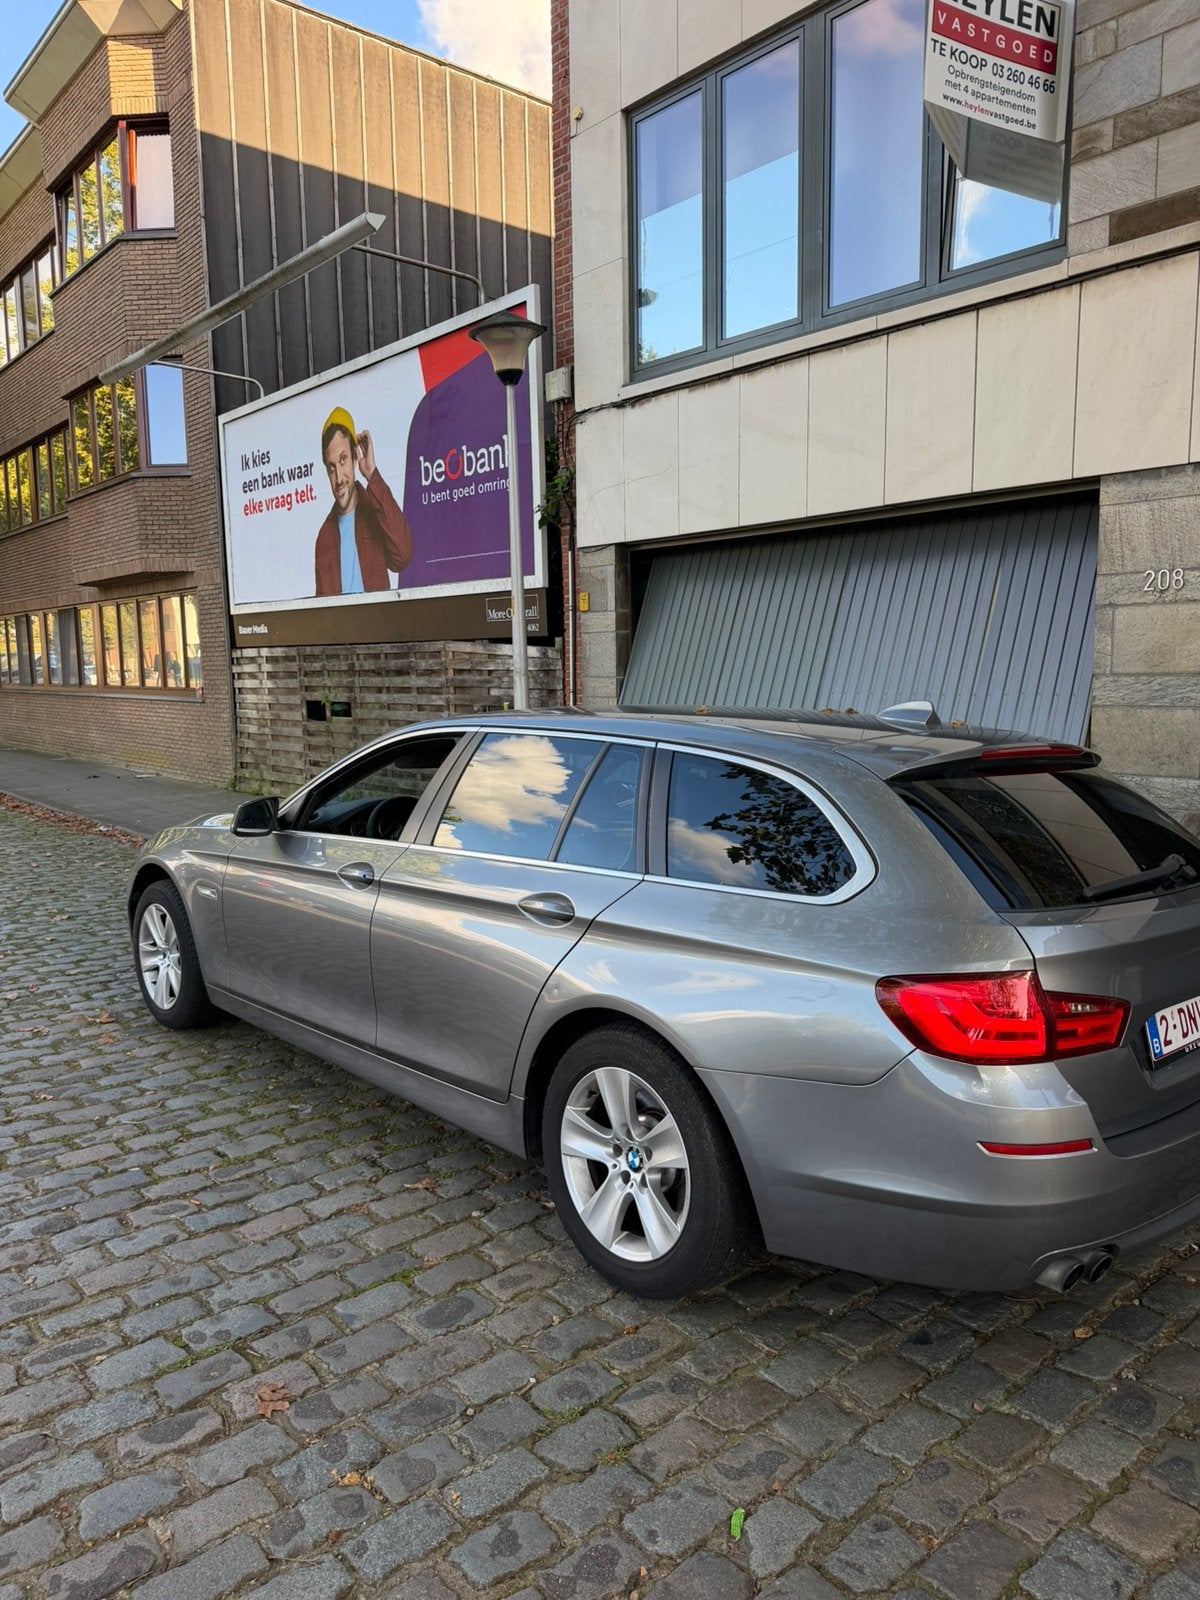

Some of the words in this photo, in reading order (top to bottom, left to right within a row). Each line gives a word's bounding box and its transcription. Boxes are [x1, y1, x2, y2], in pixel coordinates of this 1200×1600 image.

[952, 0, 1055, 37] YLEN
[938, 10, 1053, 62] VASTGOED
[931, 38, 947, 57] TE
[950, 46, 988, 71] KOOP
[992, 62, 1004, 78] 03
[1006, 67, 1025, 85] 260
[1028, 74, 1040, 89] 46
[1043, 79, 1055, 94] 66
[945, 79, 961, 90] met
[963, 85, 969, 93] 4
[970, 89, 1036, 116] appartementen
[947, 64, 1035, 102] Opbrengsteigendom
[942, 92, 1037, 130] www.heylenvastgoed.be
[241, 454, 250, 472] Ik
[252, 449, 271, 469] kies
[242, 478, 259, 494] een
[261, 466, 285, 489] bank
[287, 462, 314, 482] waar
[422, 493, 428, 505] U
[431, 489, 450, 503] bent
[452, 482, 475, 502] goed
[243, 498, 263, 516] elke
[265, 492, 293, 511] vraag
[295, 484, 317, 504] telt.
[1143, 568, 1184, 591] 208
[488, 609, 505, 619] More
[1153, 1038, 1160, 1053] B
